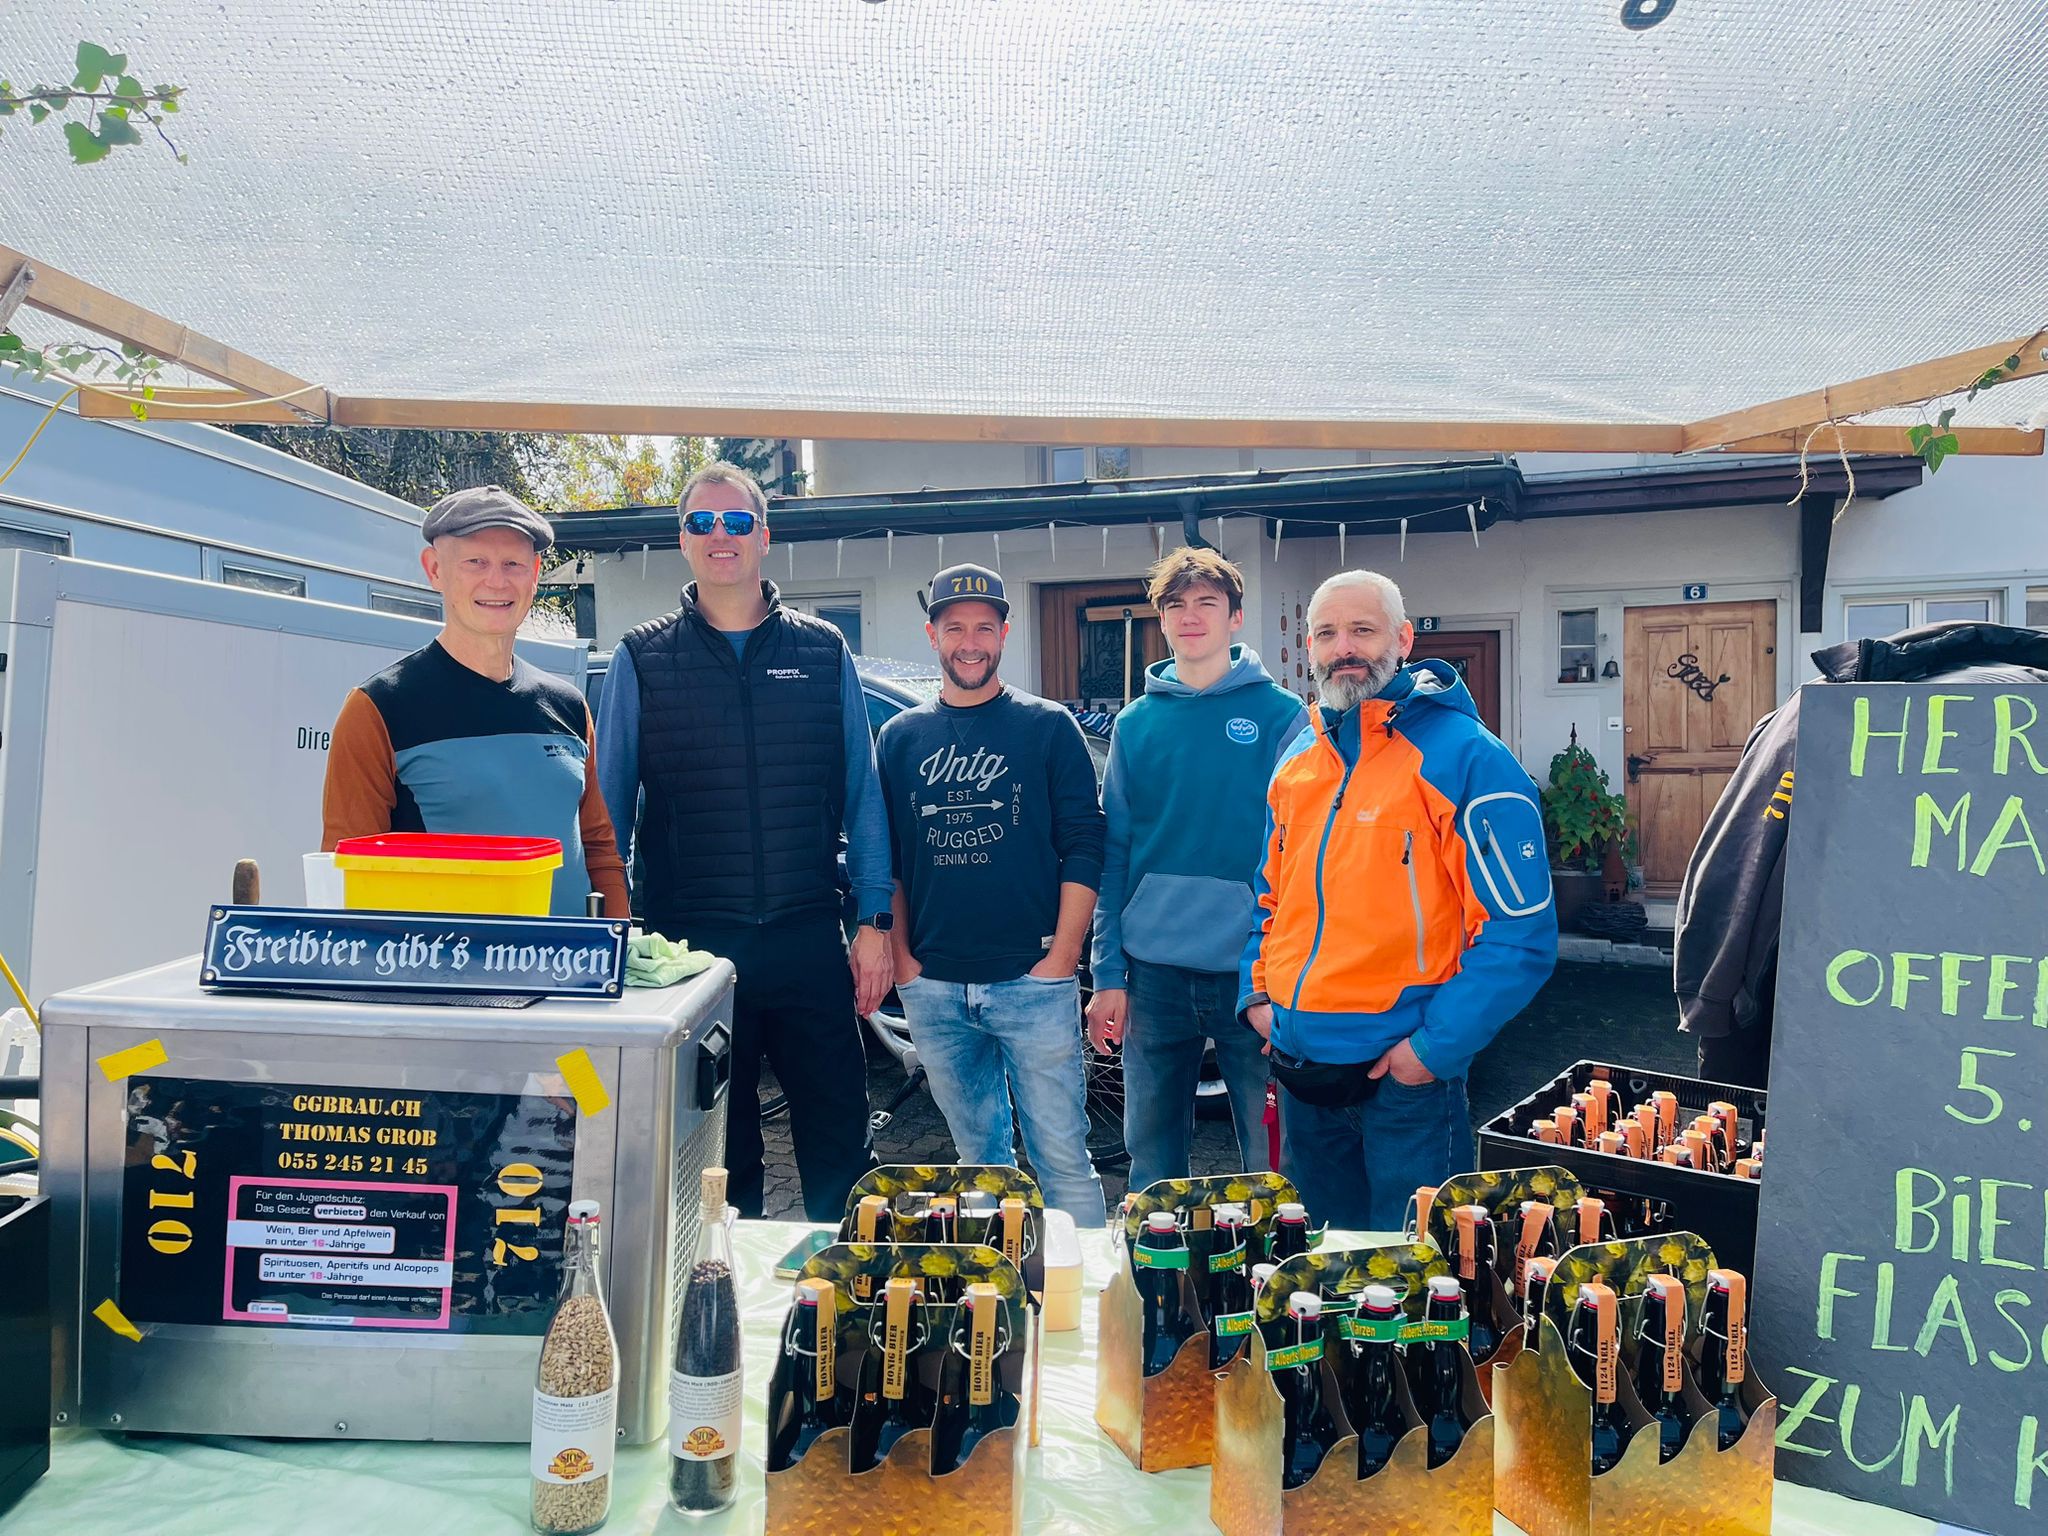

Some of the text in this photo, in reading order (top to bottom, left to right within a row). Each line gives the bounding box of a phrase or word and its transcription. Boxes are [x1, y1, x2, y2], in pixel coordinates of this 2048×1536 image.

[951, 576, 988, 594] 710
[1690, 586, 1700, 599] 6
[1423, 618, 1433, 631] 8
[766, 668, 800, 676] PROFFIX
[297, 727, 330, 751] Dire
[919, 744, 1009, 792] Vntg
[947, 790, 973, 802] EST.
[1012, 783, 1022, 825] MADE
[945, 812, 973, 824] 1975
[926, 823, 1004, 849] RUGGED
[1911, 791, 2047, 877] MA
[933, 852, 991, 866] DENIM CO.
[223, 925, 367, 972] Freibier
[483, 942, 612, 981] morgen
[293, 1095, 421, 1118] GGBRAU.CH
[280, 1123, 437, 1147] THOMAS GROB
[278, 1152, 428, 1176] 055 245 21 45
[147, 1149, 197, 1255] 710
[255, 1190, 366, 1205] Für den Jugendschutz:
[255, 1204, 445, 1220] Das Gesetz verbietet den Verkauf von
[492, 1162, 544, 1267] 710
[1895, 1167, 2048, 1271] BiE
[265, 1238, 277, 1246] an
[280, 1238, 308, 1247] unter
[266, 1225, 391, 1241] Wein, Bier und Apfelwein
[263, 1257, 439, 1273] Spirituosen, Aperitifs und Alcopops
[263, 1271, 275, 1279] an
[278, 1271, 306, 1280] unter
[1816, 1252, 2048, 1372] FLAS
[820, 1325, 828, 1351] BIER
[888, 1324, 898, 1350] BIER
[975, 1330, 984, 1356] BIER
[819, 1352, 828, 1388] HONIG
[886, 1352, 896, 1386] HONIG
[973, 1357, 982, 1393] HONIG
[1600, 1361, 1608, 1391] 1124
[1667, 1352, 1675, 1379] 1124
[1774, 1366, 1961, 1497] ZUM
